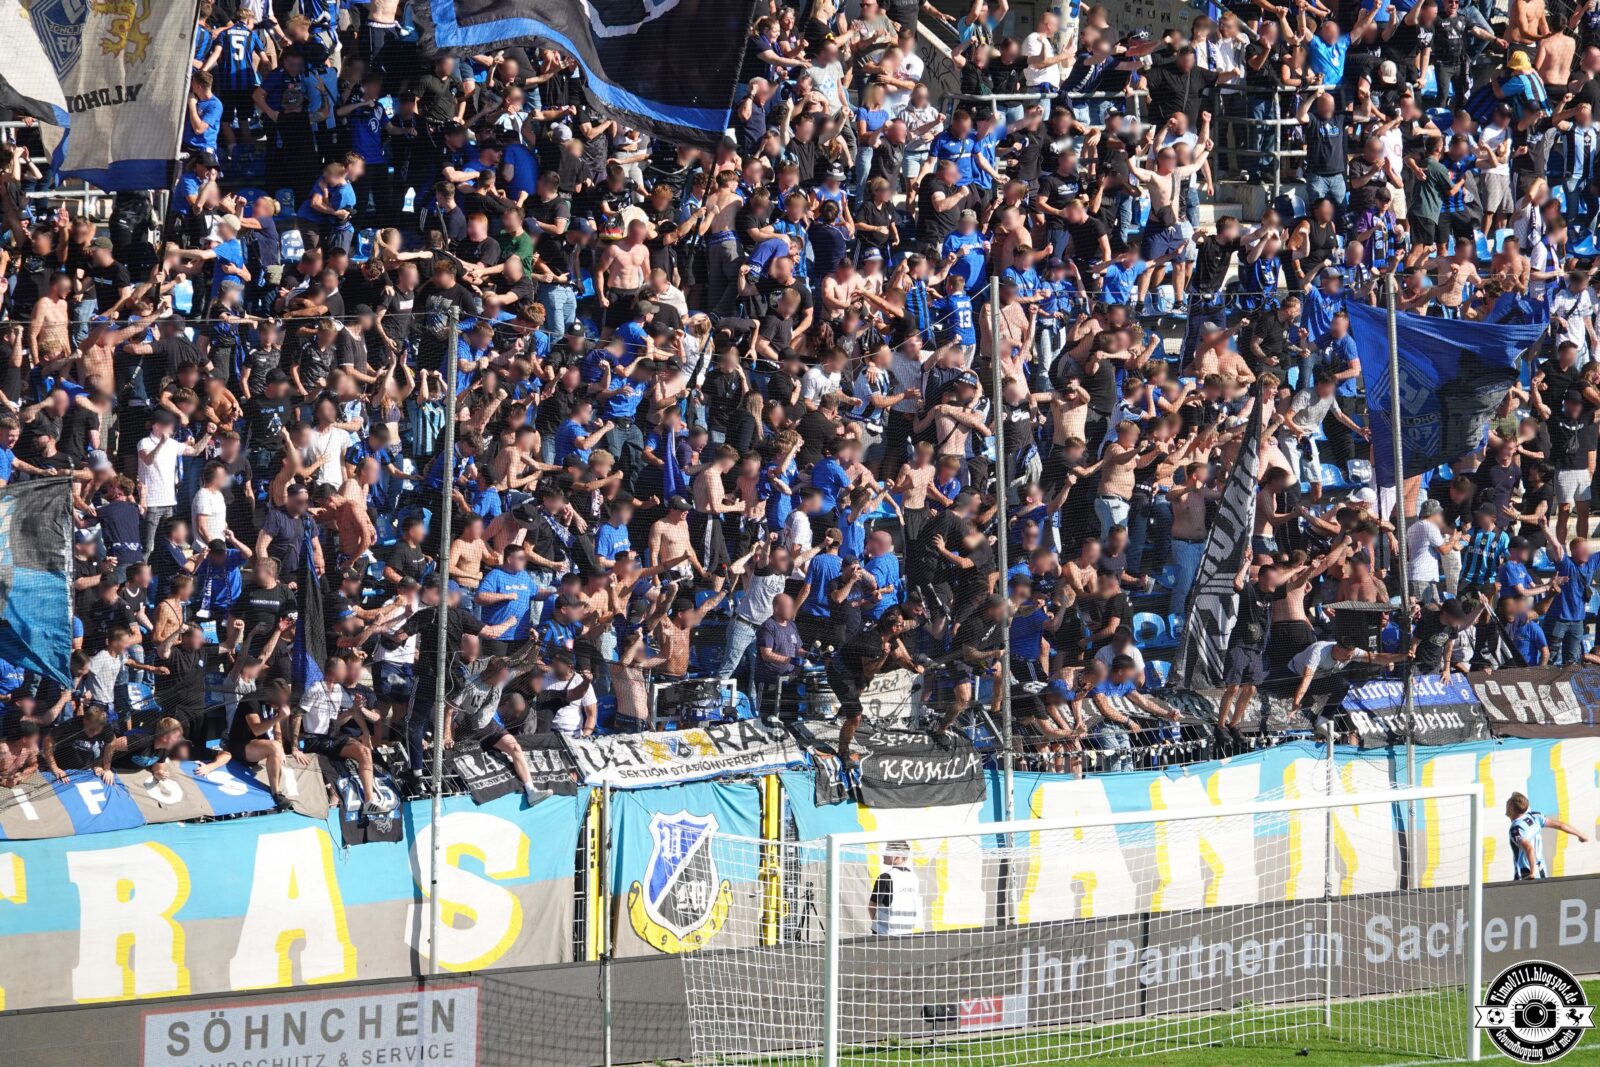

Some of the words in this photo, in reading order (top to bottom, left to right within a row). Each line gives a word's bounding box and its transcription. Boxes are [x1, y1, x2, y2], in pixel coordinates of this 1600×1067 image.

[231, 35, 245, 61] 5
[958, 309, 972, 329] 13
[618, 766, 669, 779] SEKTION
[879, 752, 981, 786] KROMILA
[1021, 946, 1087, 995] Ihr
[1106, 934, 1286, 988] Partner
[1303, 922, 1343, 969] in
[1364, 908, 1538, 964] Sachen
[1559, 898, 1600, 946] B
[166, 998, 455, 1057] SÖHNCHEN
[338, 1052, 349, 1066] &
[362, 1043, 454, 1065] SERVICE
